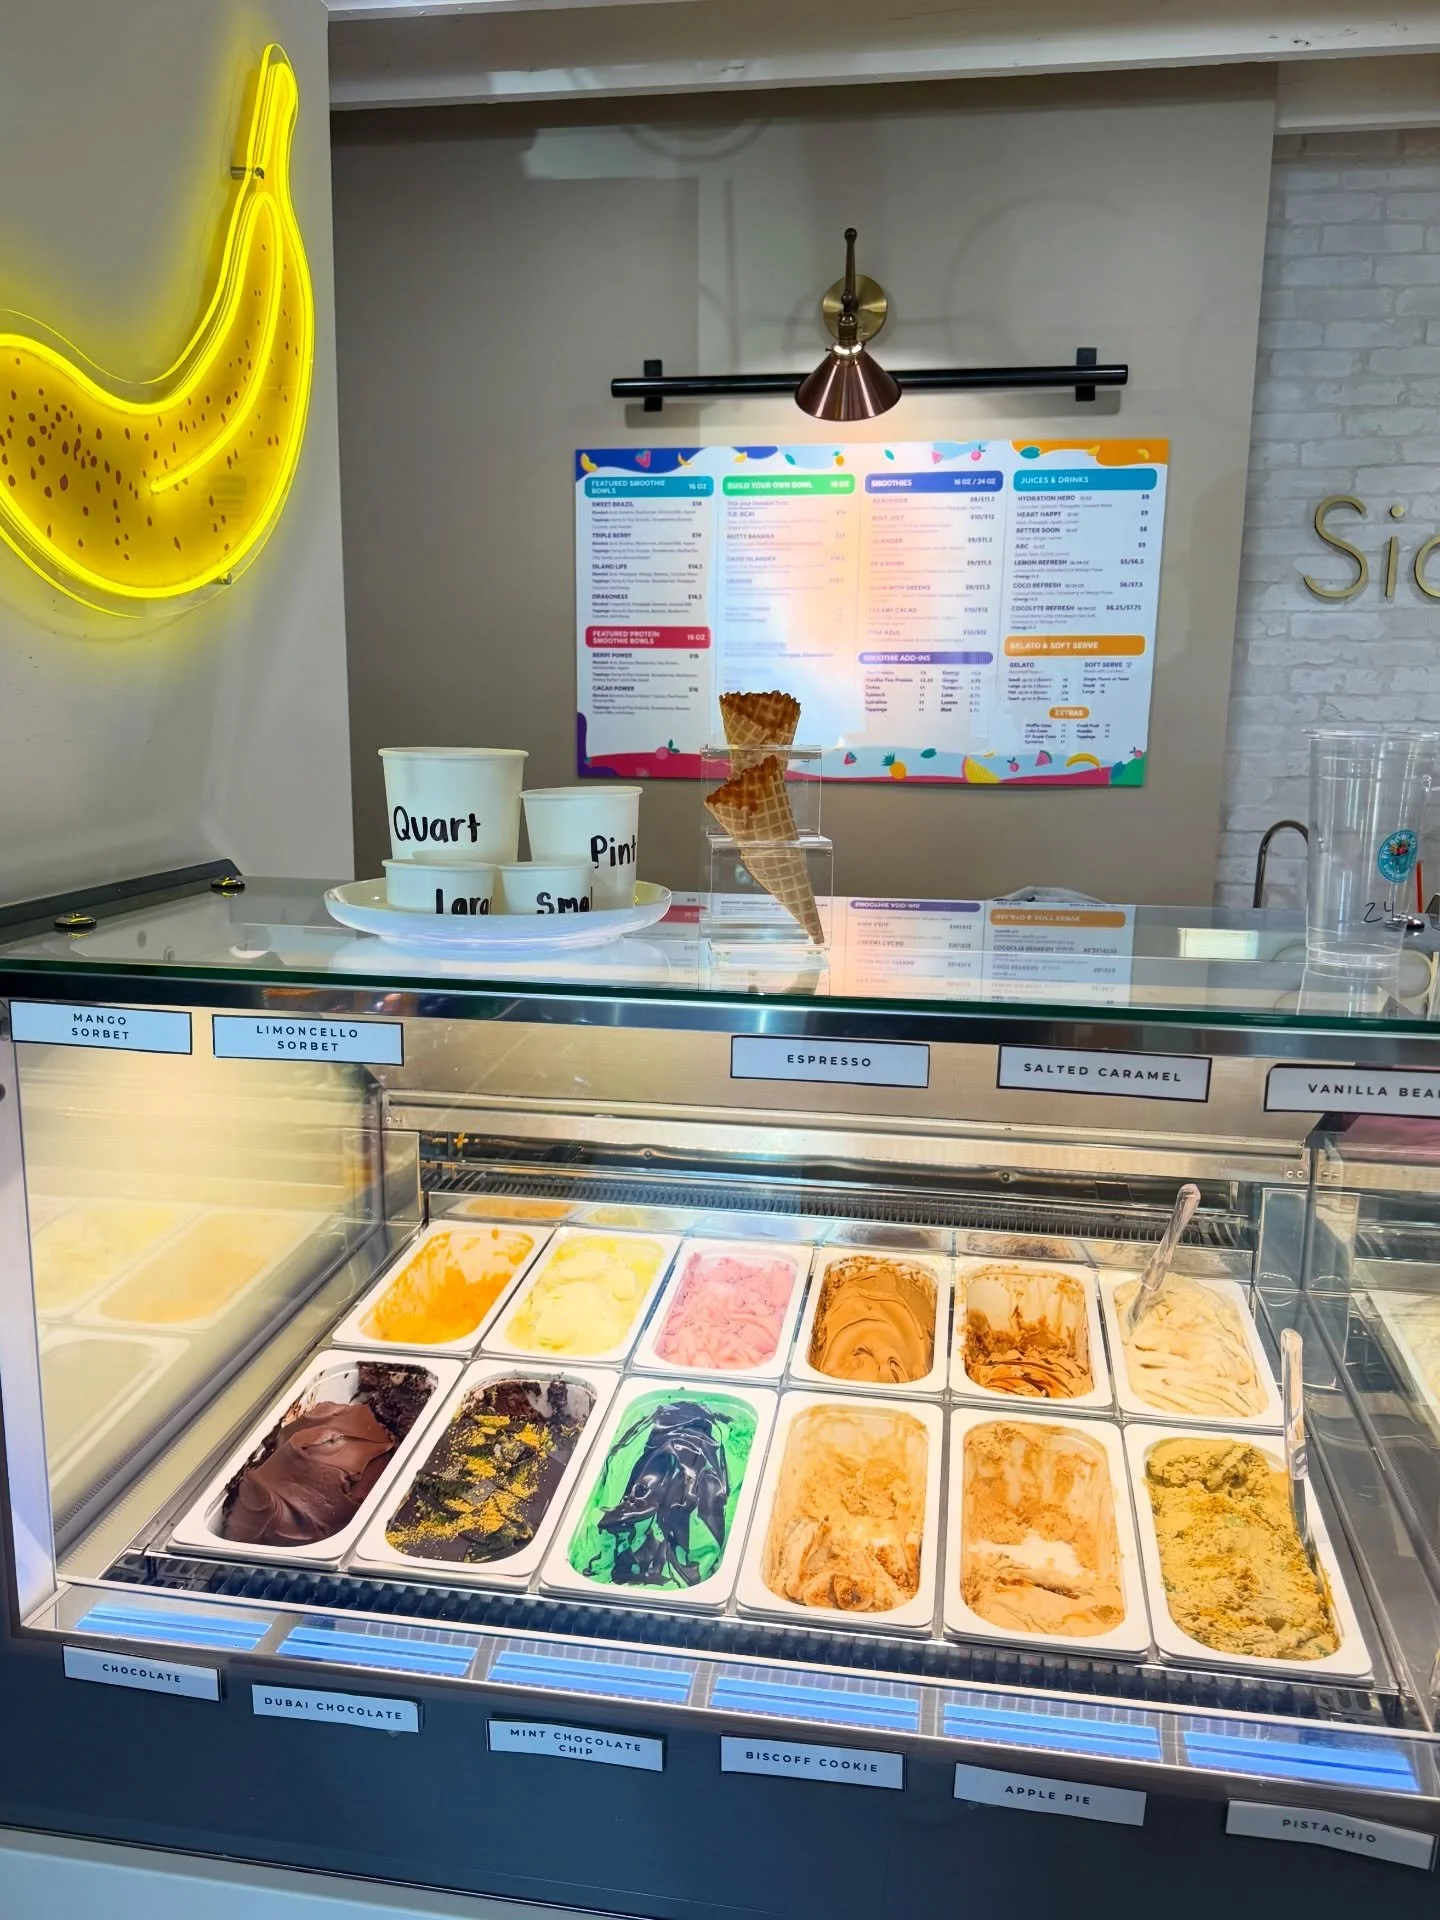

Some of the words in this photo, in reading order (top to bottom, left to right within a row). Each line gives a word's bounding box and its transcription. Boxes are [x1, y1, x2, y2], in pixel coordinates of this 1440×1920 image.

[689, 482, 696, 490] 16
[697, 482, 708, 490] OZ
[728, 481, 750, 490] BUILD
[751, 481, 771, 489] YOUR
[772, 481, 791, 489] OWN
[791, 480, 813, 489] BOWL
[871, 478, 912, 487] SMOOTHIES
[1020, 476, 1049, 484] JUICES
[1057, 476, 1089, 484] DRINKS
[1010, 641, 1041, 649] GELATO
[1050, 641, 1071, 649] SOFT
[1072, 641, 1099, 649] SERVE
[393, 805, 481, 843] Quart
[590, 834, 637, 869] Pint
[1363, 901, 1396, 923] 24
[72, 1013, 128, 1026] MANGO
[71, 1026, 131, 1041] SORBET
[256, 1024, 360, 1039] LIMONCELLO
[276, 1039, 340, 1053] SORBET
[786, 1053, 873, 1068] ESPRESSO
[1023, 1062, 1091, 1076] SALTED
[1098, 1067, 1183, 1083] CARAMEL
[1307, 1083, 1390, 1097] VANILLA
[101, 1662, 183, 1684] CHOCOLATE
[263, 1696, 311, 1711] DUBAI
[316, 1701, 404, 1721] CHOCOLATE
[509, 1728, 547, 1740] MINT
[552, 1731, 643, 1752] CHOCOLATE
[557, 1743, 595, 1757] CHIP
[745, 1749, 812, 1768] BISCOFF
[818, 1757, 879, 1773] COOKIE
[1004, 1784, 1057, 1801] APPLE
[1064, 1792, 1092, 1805] PIE
[1281, 1817, 1378, 1844] PISTACHIO
